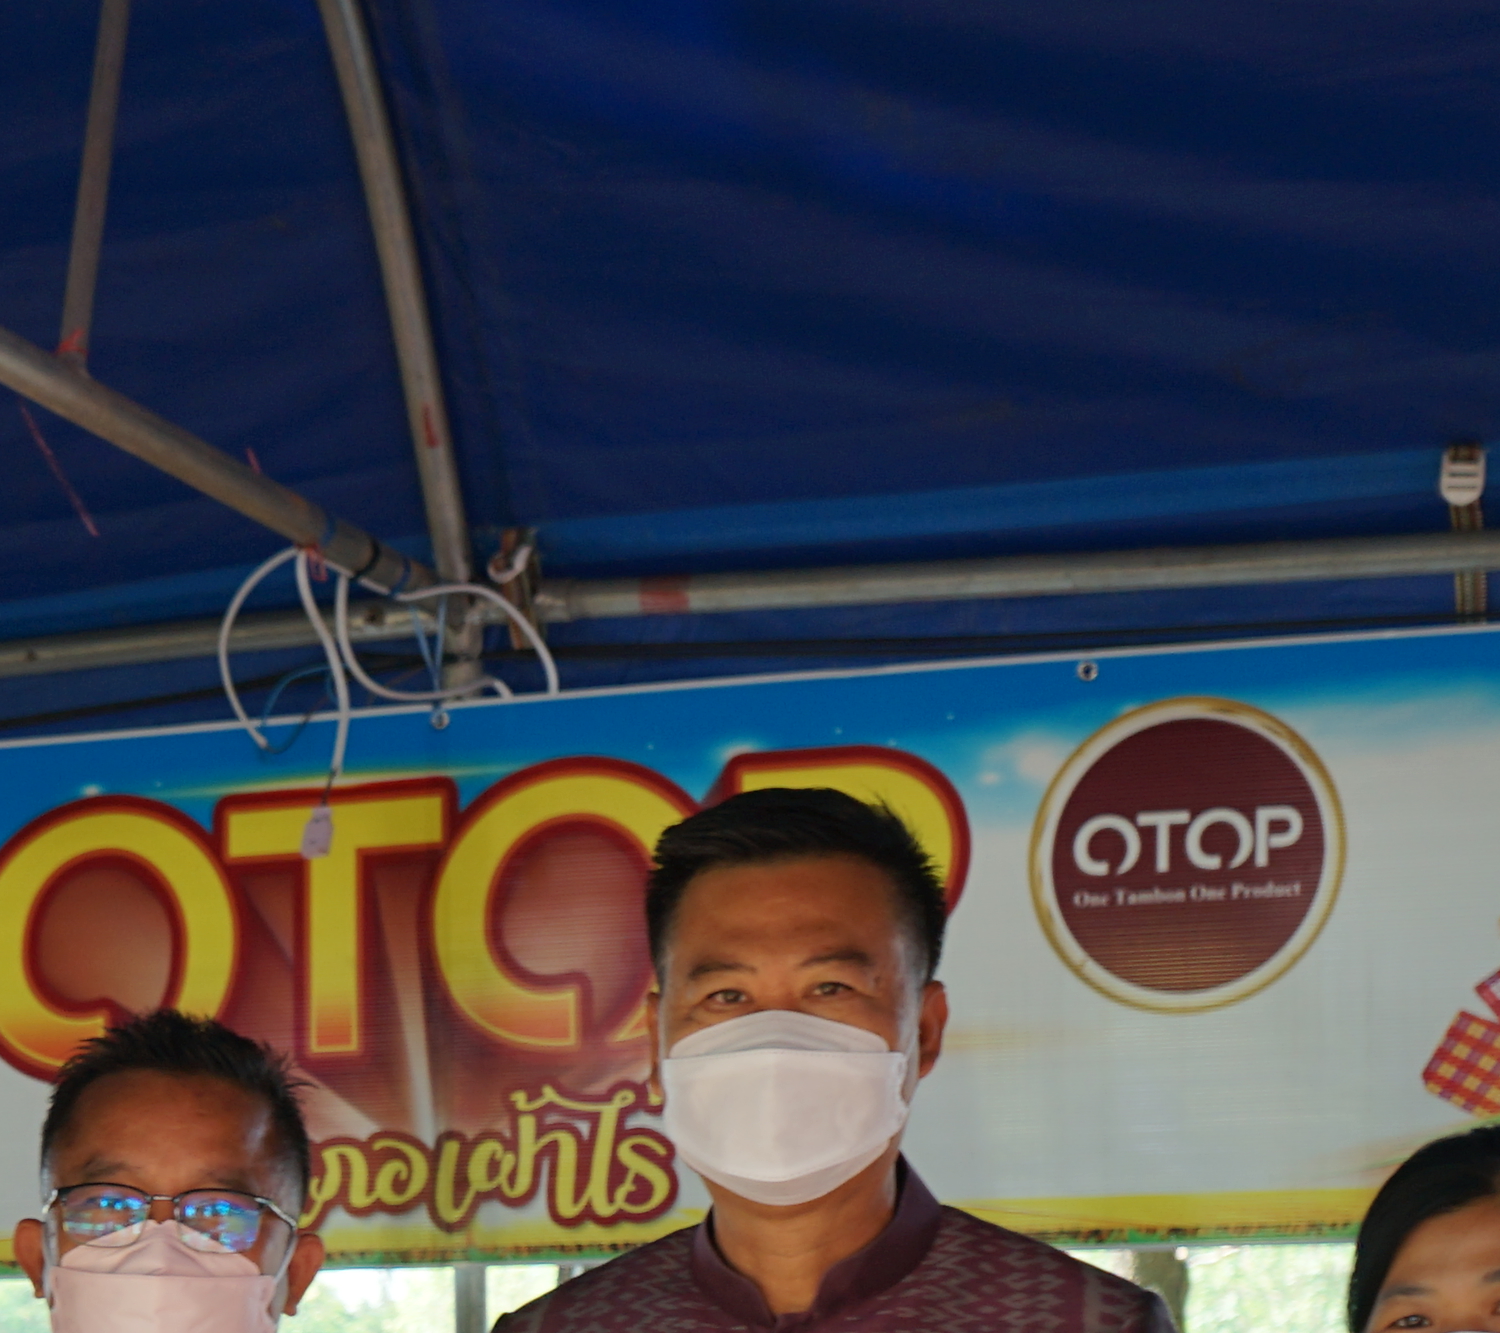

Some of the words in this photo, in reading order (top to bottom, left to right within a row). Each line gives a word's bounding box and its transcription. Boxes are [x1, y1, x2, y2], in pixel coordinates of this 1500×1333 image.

[1072, 804, 1303, 878] OTOP
[1072, 887, 1109, 908] One
[1115, 884, 1187, 906] Tambon
[1189, 882, 1227, 902] One
[1230, 879, 1301, 900] Product
